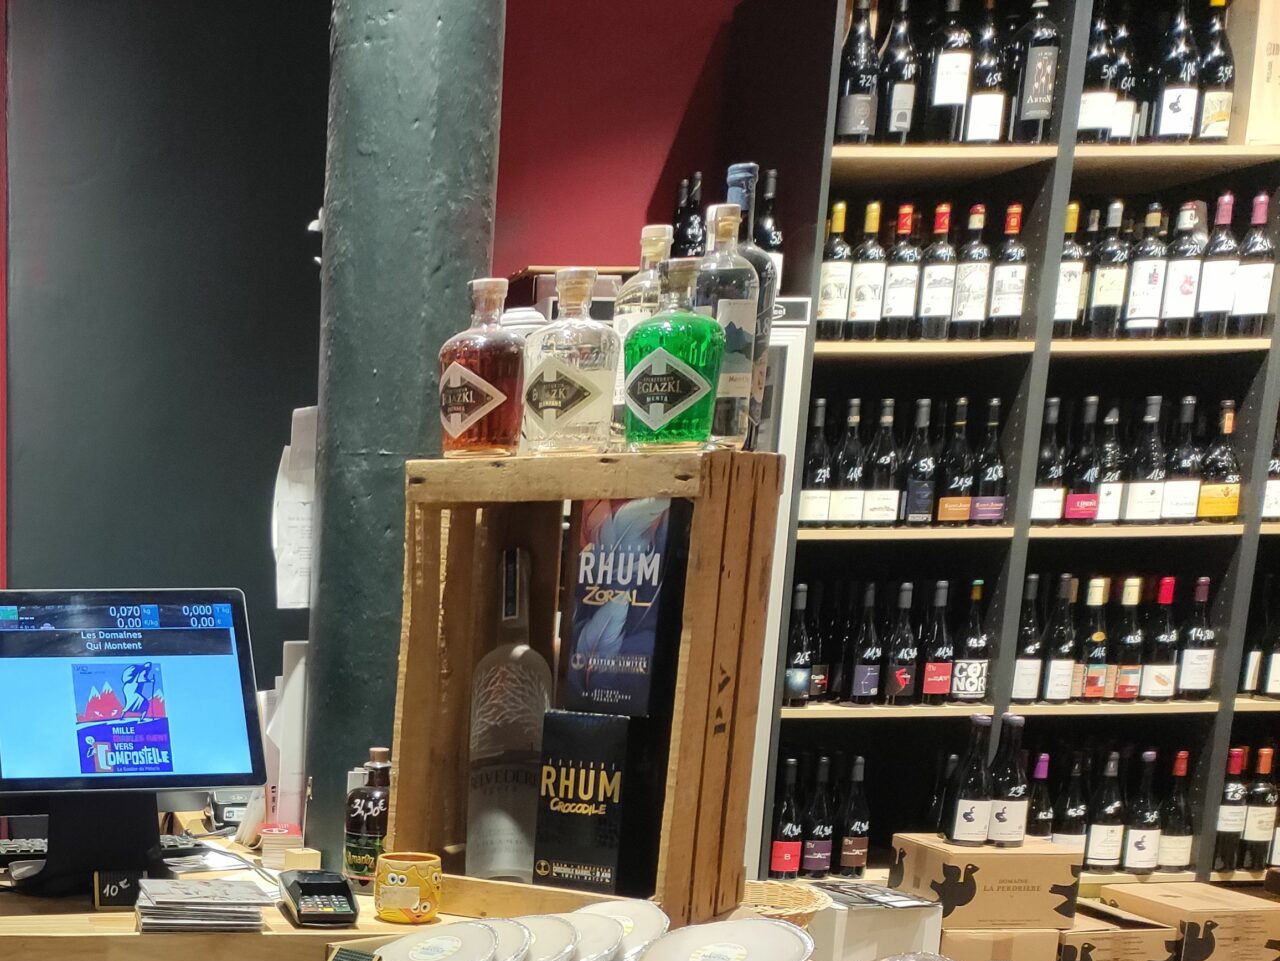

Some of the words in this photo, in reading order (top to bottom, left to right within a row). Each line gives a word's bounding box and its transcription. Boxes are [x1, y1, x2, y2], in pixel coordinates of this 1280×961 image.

[579, 552, 660, 586] RHUM
[582, 587, 651, 607] ZORZAL
[109, 606, 140, 618] 0,070
[183, 605, 212, 617] 0,000
[117, 618, 142, 629] 0,00
[191, 617, 215, 628] 0,00
[81, 631, 97, 640] Les
[99, 631, 142, 640] Domaines
[86, 642, 103, 651] Qui
[105, 641, 142, 651] Montent
[112, 727, 135, 735] MILLE
[97, 744, 170, 770] COMPOSTELLE
[541, 765, 621, 803] RHUM
[550, 797, 607, 816] CROCODILE
